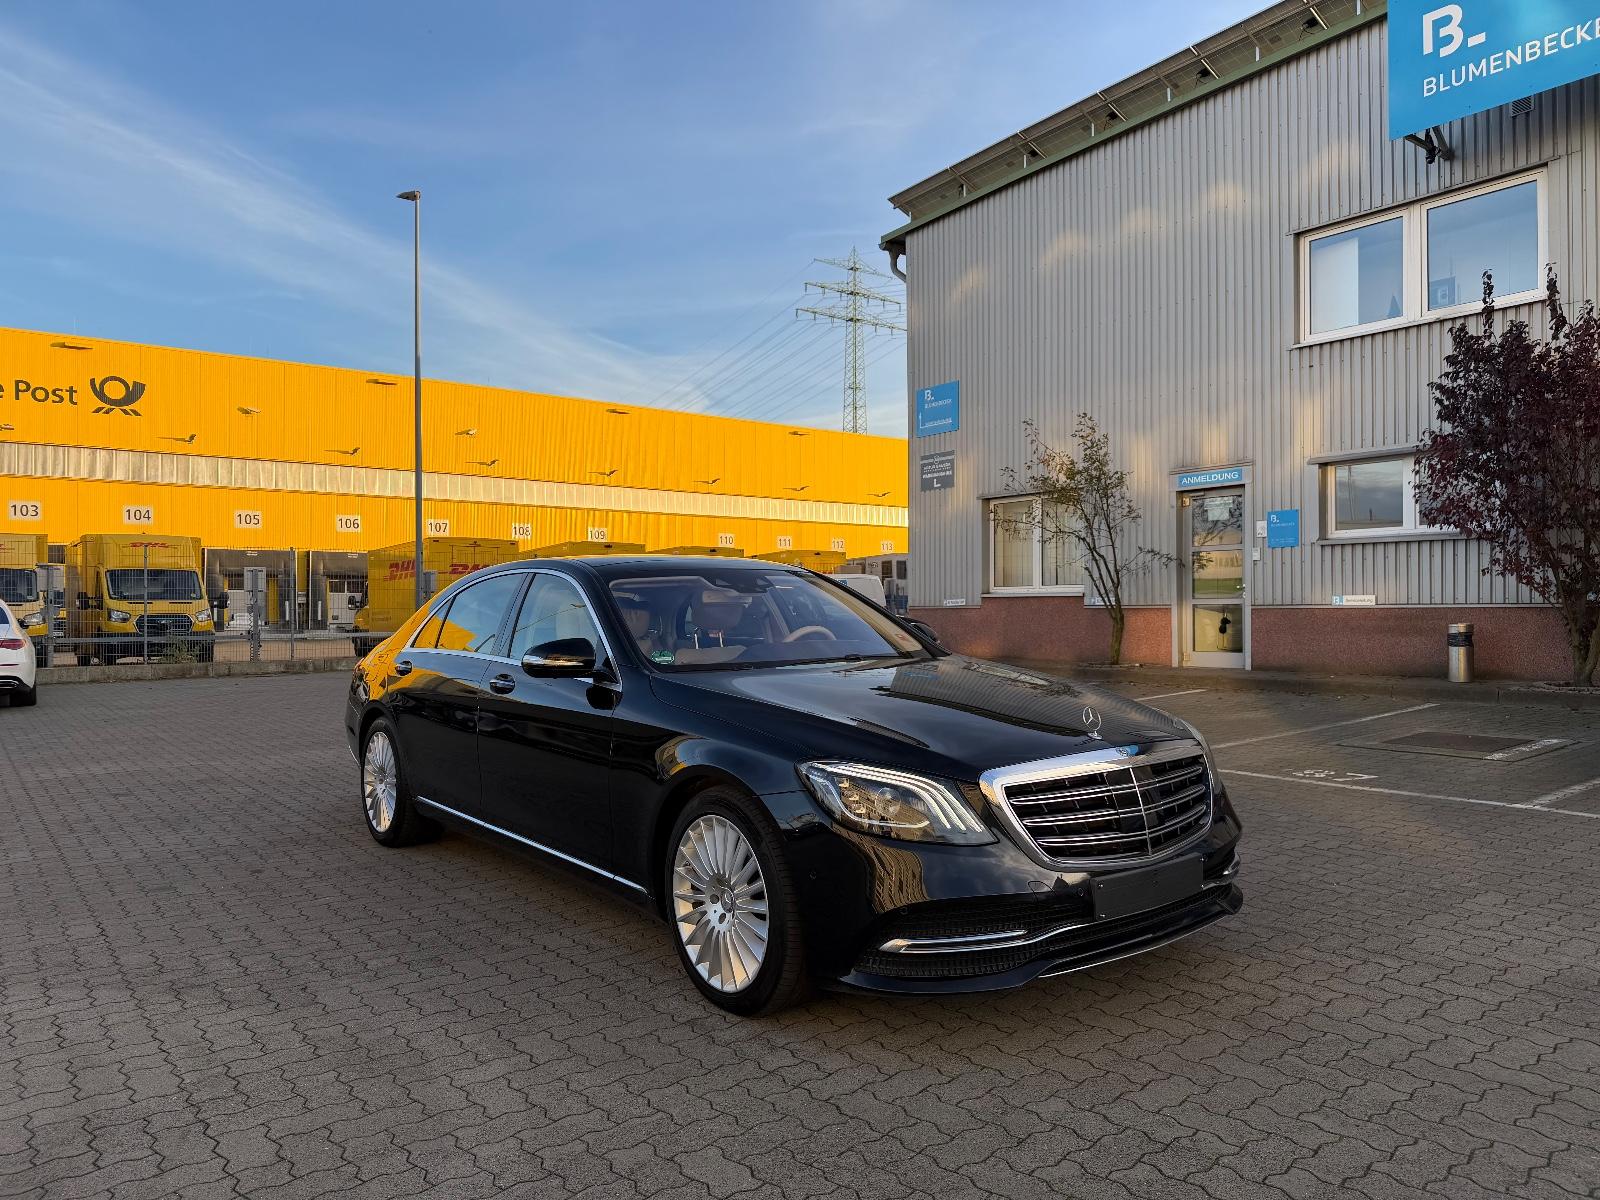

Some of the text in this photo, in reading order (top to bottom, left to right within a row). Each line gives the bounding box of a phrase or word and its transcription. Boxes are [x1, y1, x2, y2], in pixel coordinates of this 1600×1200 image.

[1423, 17, 1600, 98] BLUMENBECK
[14, 379, 78, 405] Post
[1181, 471, 1239, 485] ANMELDUNG
[10, 504, 39, 517] 103
[125, 508, 152, 521] 104
[236, 513, 260, 525] 105
[338, 517, 360, 529] 106
[428, 522, 448, 533] 107
[513, 526, 531, 537] 108
[589, 529, 605, 541] 109
[719, 535, 734, 545] 110
[778, 538, 792, 547] 111
[832, 540, 844, 549] 112
[881, 542, 893, 551] 113
